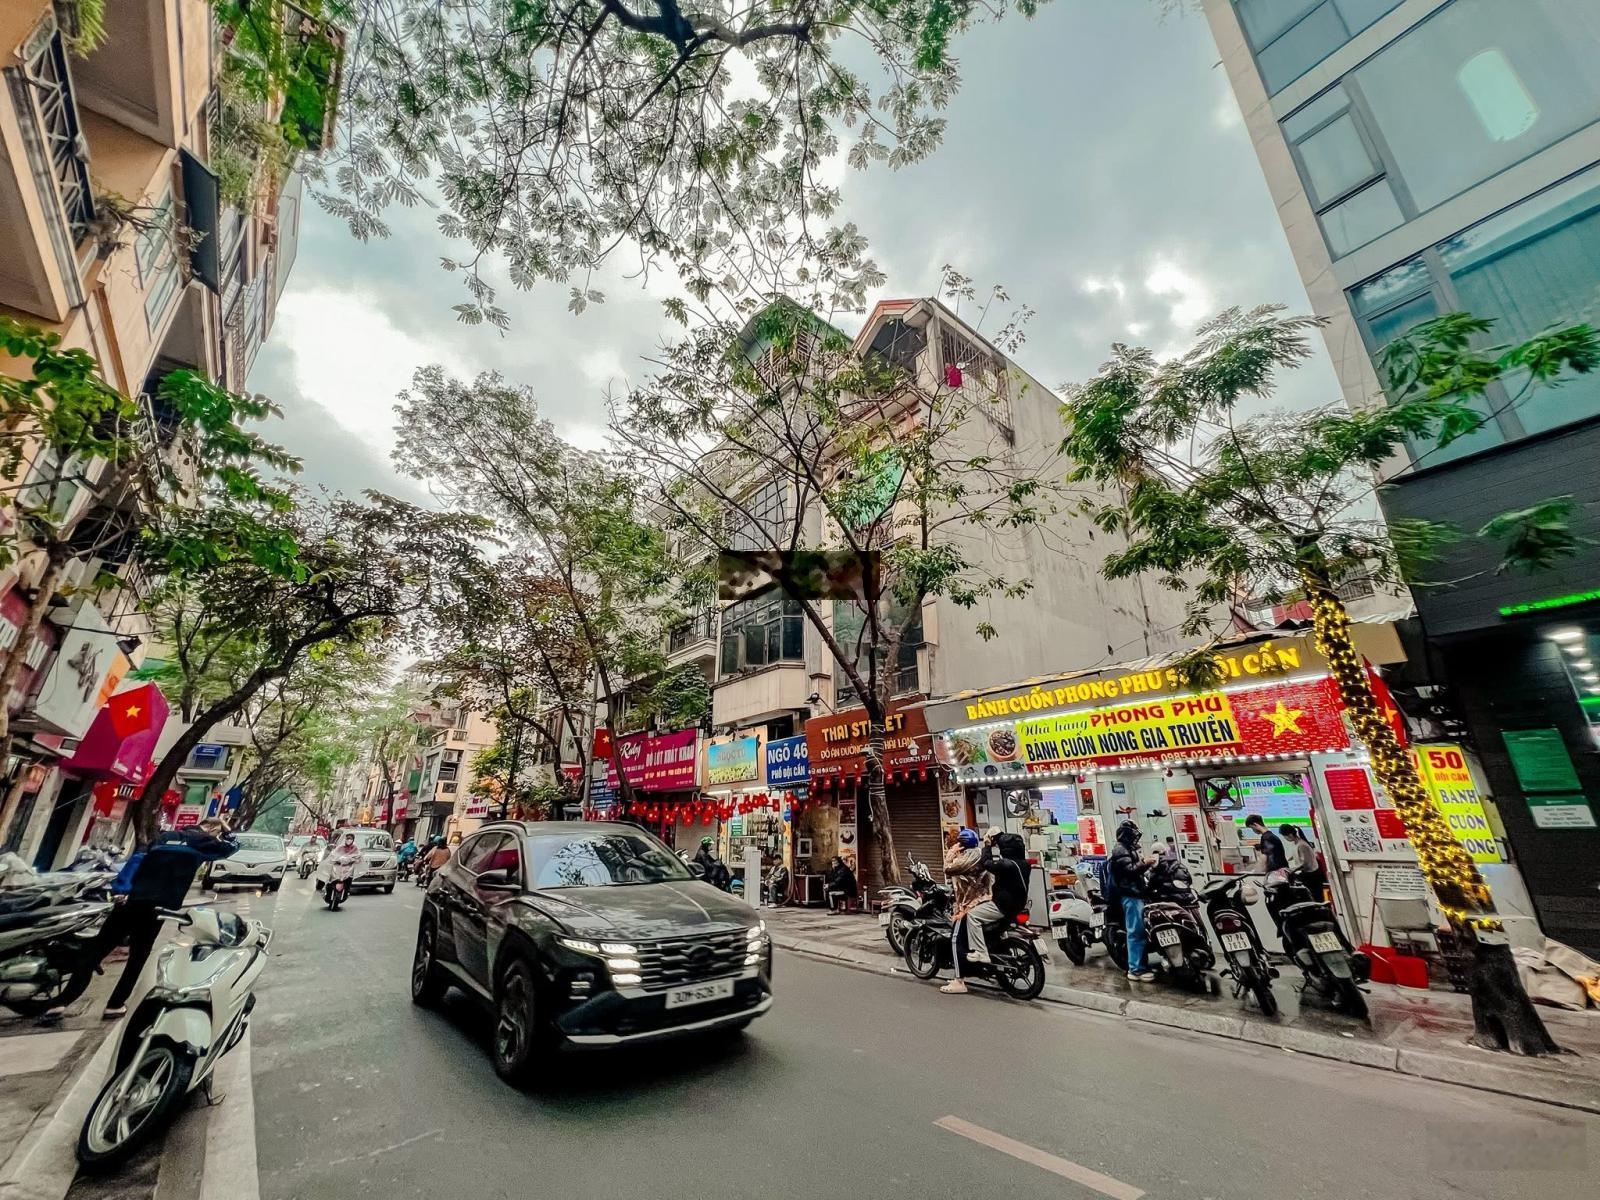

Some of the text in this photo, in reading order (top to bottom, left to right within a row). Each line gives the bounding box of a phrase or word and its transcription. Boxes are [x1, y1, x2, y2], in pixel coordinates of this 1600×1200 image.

[966, 697, 1009, 720] BÁNH
[1009, 686, 1056, 712] CUỐN
[1055, 680, 1120, 705] PHONG
[1021, 693, 1223, 737] Nhà hàng PHONG PHÚ
[822, 713, 904, 742] THAI STET
[1026, 713, 1235, 761] BÁNH CUỐN NÓNG GIA TRUYỀN
[768, 742, 808, 764] NGÕ 46
[1119, 755, 1158, 766] Hotline:
[1428, 751, 1463, 769] 50
[1050, 763, 1061, 772] 50
[1439, 785, 1478, 804] BÁNH
[1449, 807, 1486, 830] CUỐN
[1462, 834, 1496, 854] ÓNG
